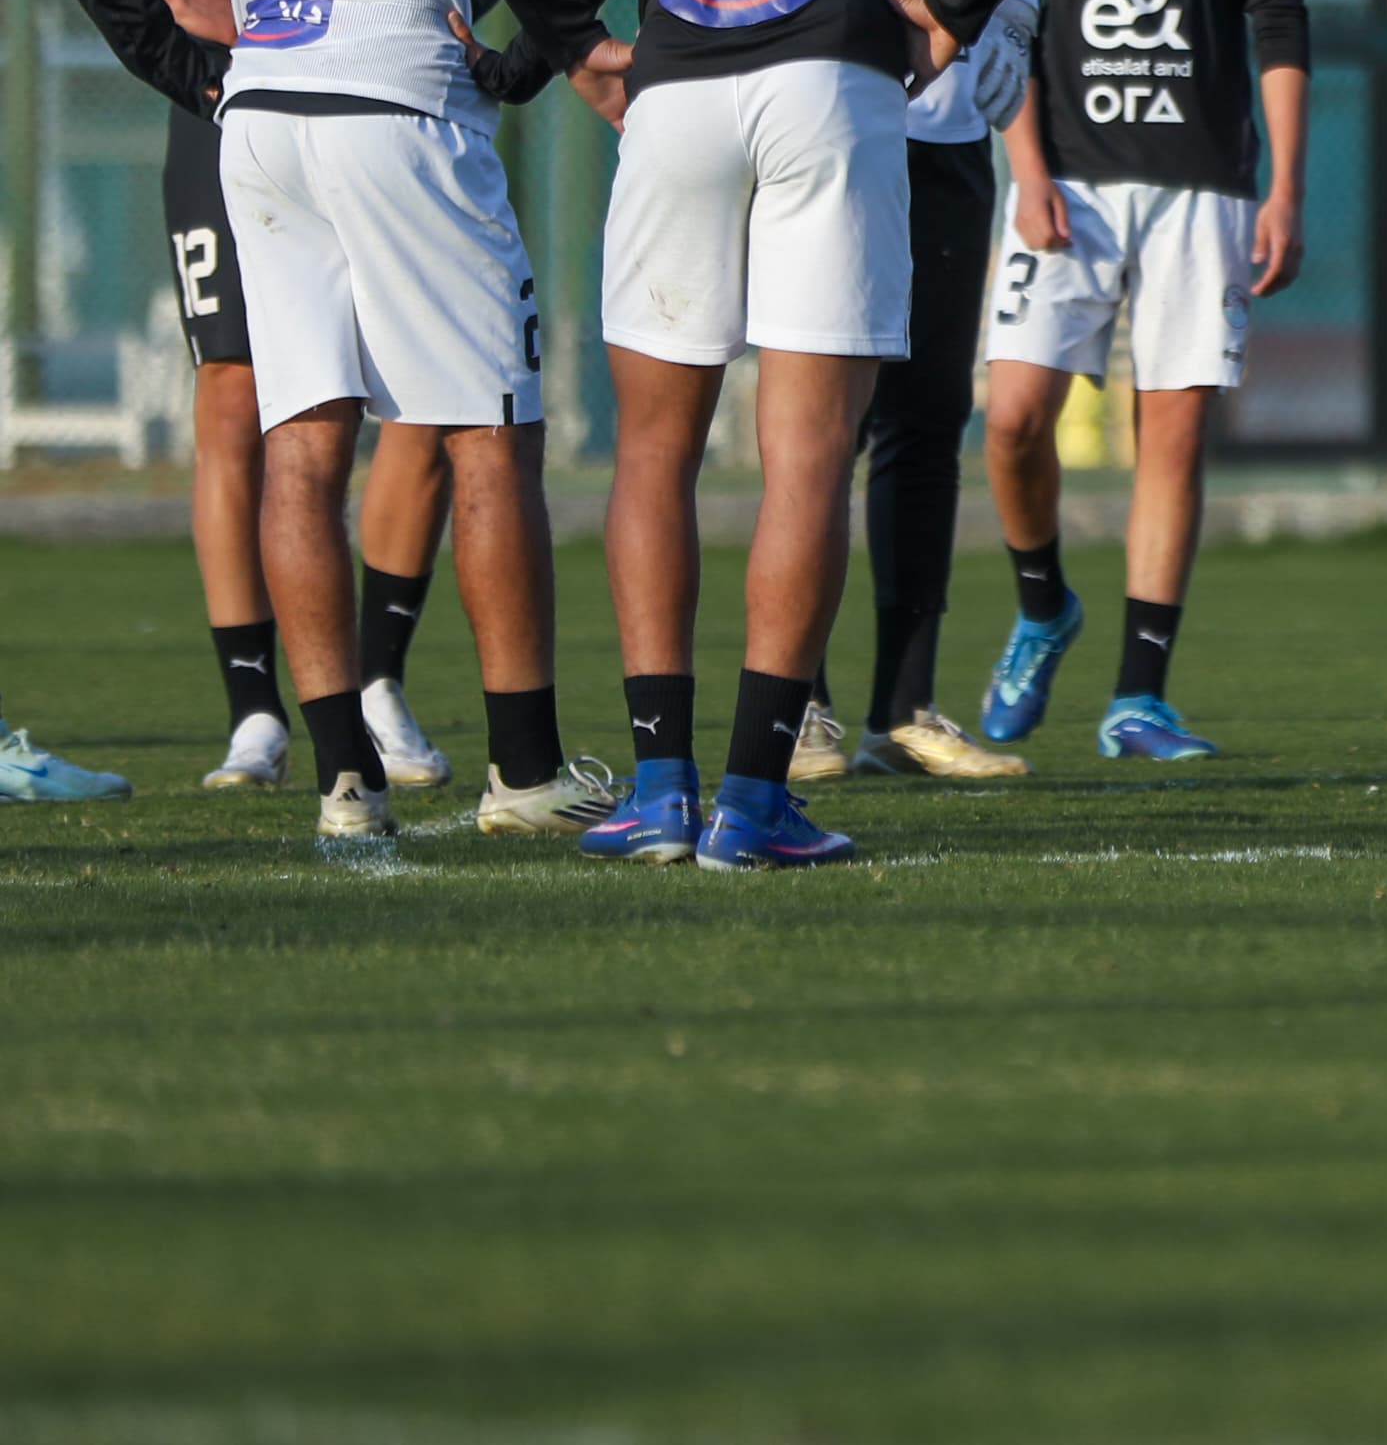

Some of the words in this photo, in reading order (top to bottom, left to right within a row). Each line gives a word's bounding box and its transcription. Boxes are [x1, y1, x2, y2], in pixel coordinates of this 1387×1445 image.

[1081, 58, 1151, 77] etisalat
[1153, 60, 1193, 77] and
[172, 226, 220, 319] 12
[996, 252, 1039, 326] 3
